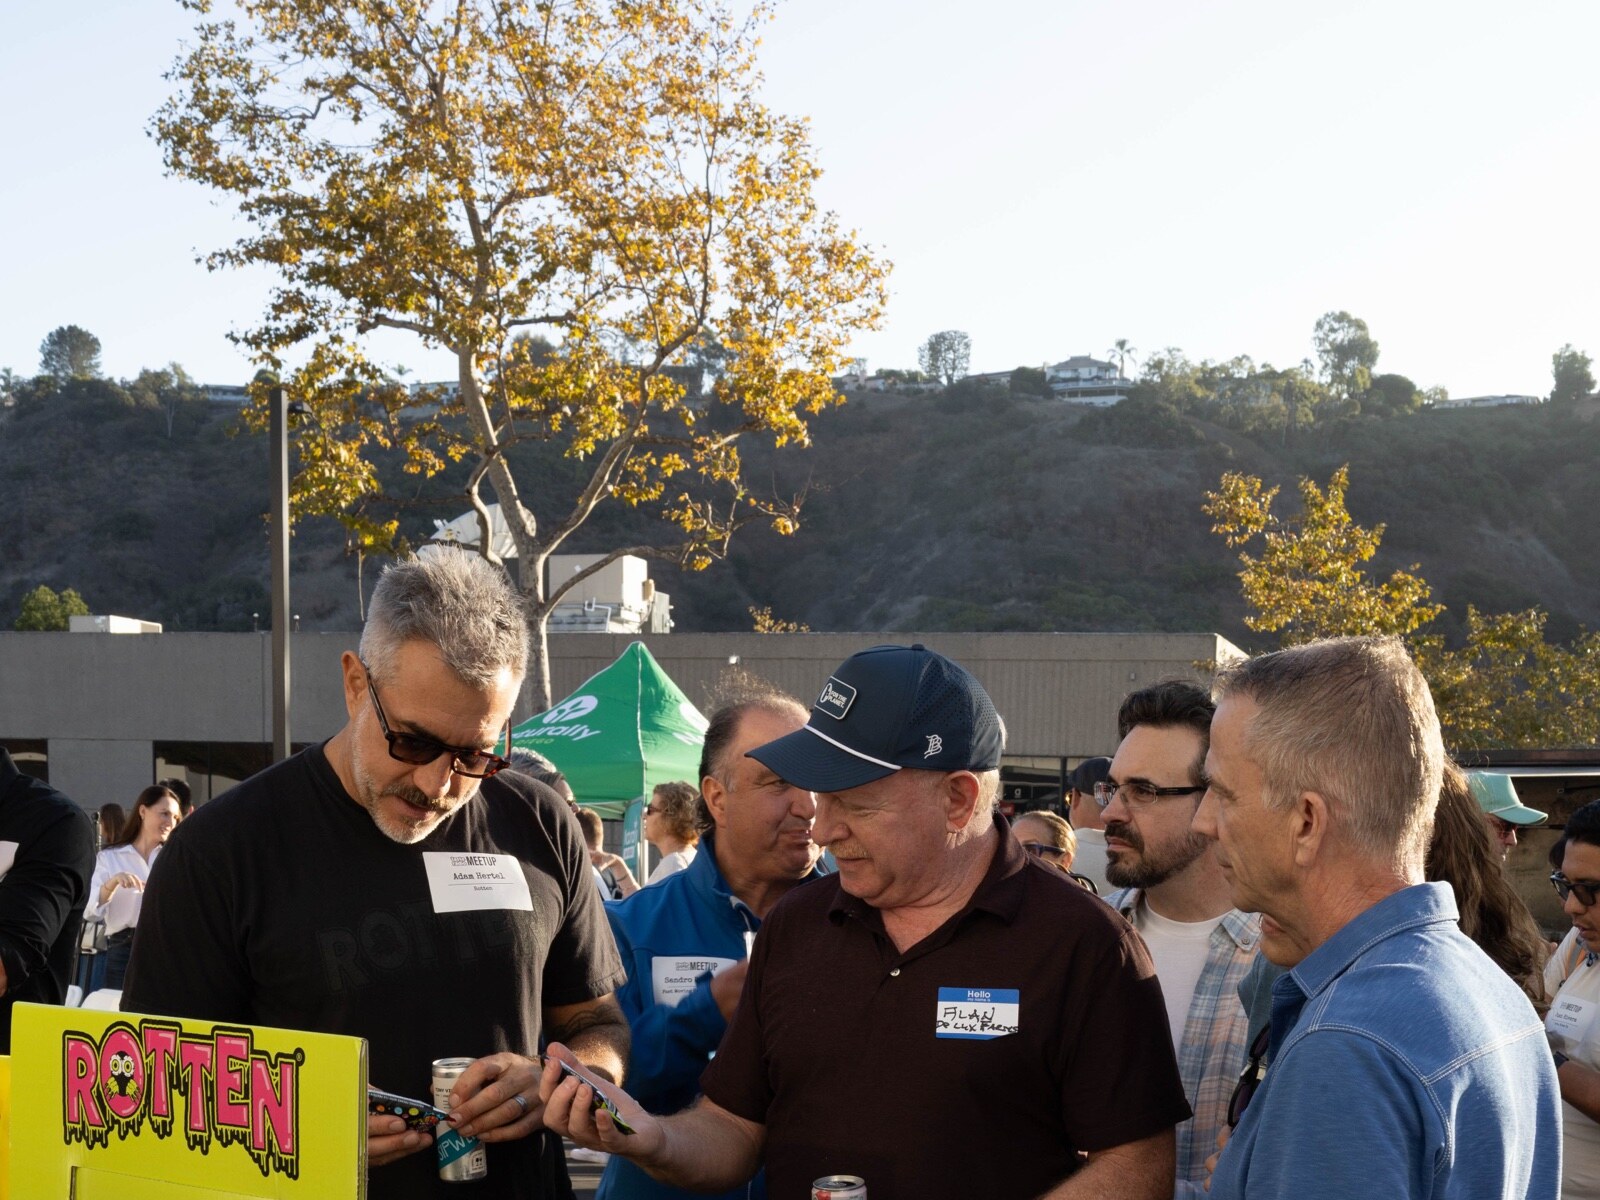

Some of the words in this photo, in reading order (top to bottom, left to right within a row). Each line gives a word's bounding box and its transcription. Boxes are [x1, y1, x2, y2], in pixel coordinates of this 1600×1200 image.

[466, 856, 496, 866] MEETUP
[453, 872, 475, 880] Adam
[690, 961, 718, 971] MEETUP
[664, 976, 693, 984] Sandro
[967, 990, 991, 998] Hello
[943, 1006, 995, 1022] ALAN
